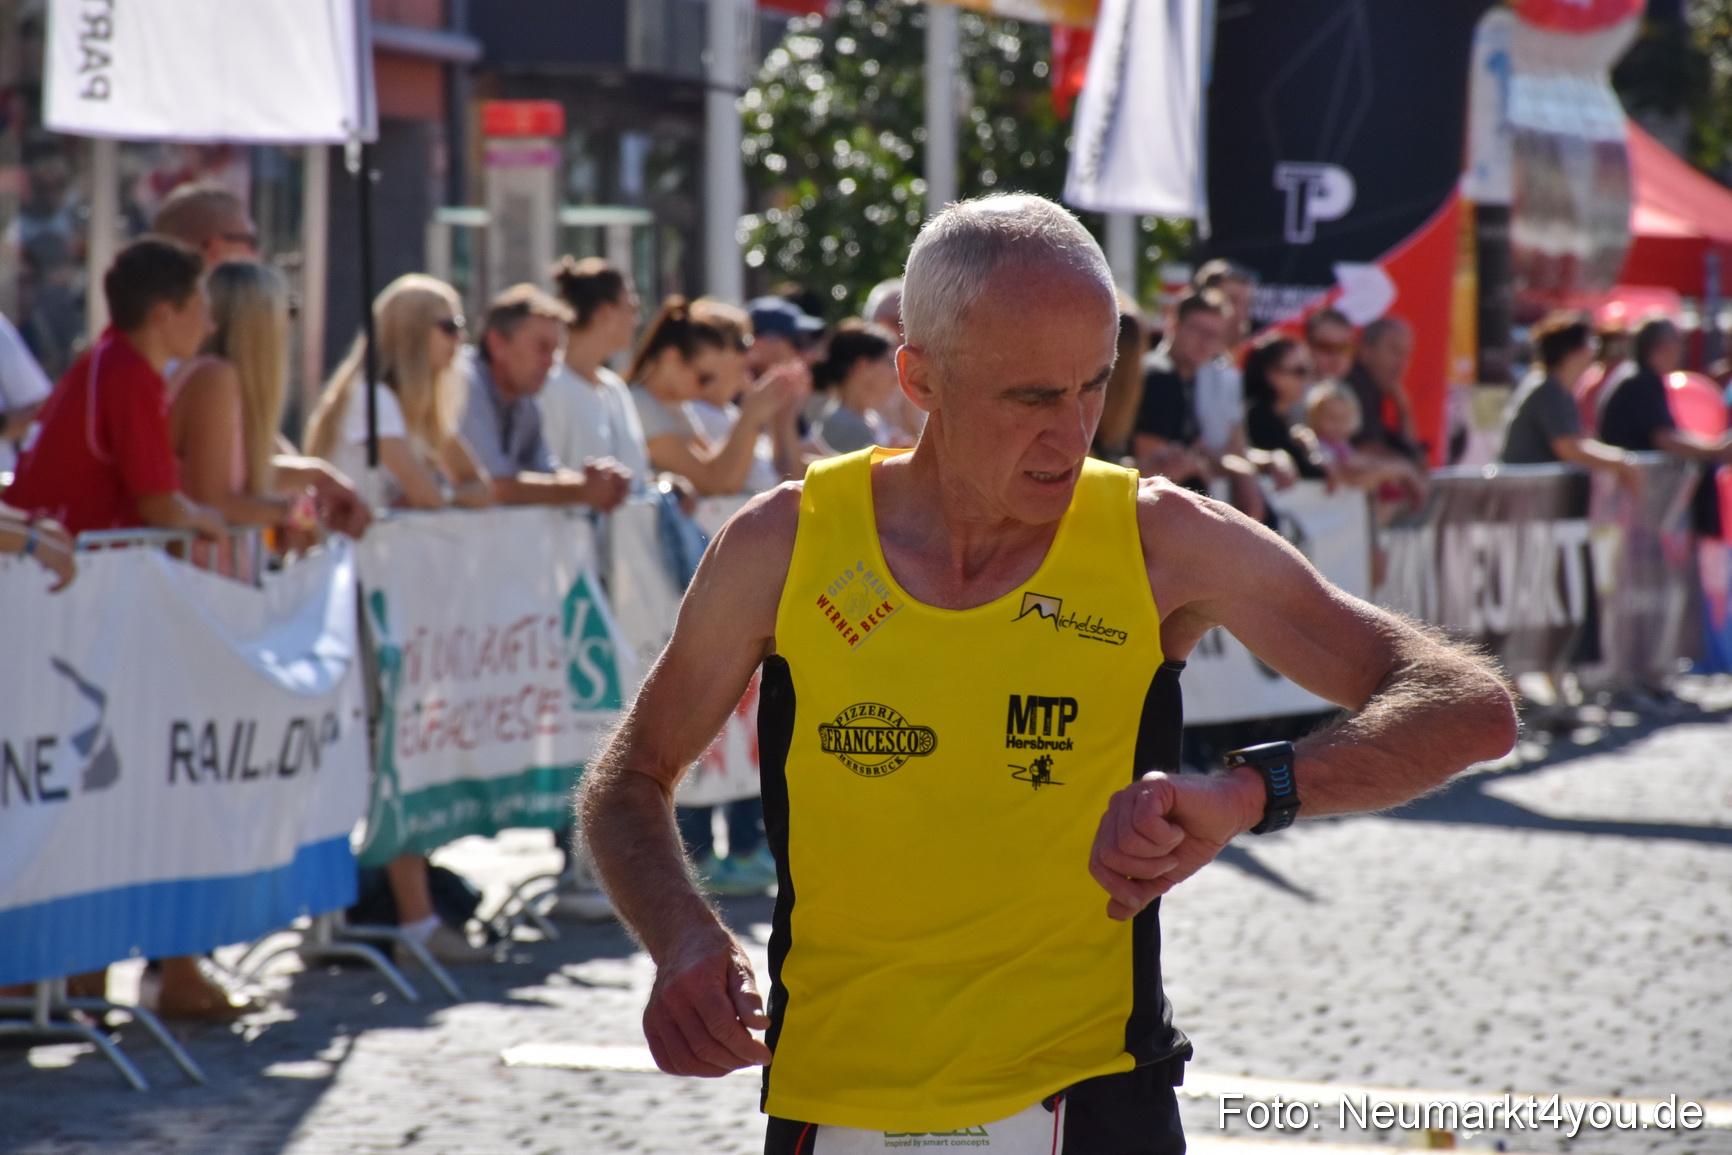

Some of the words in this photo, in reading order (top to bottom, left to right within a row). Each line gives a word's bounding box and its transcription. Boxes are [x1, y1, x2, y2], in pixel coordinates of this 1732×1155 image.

[827, 569, 855, 597] GELD
[863, 570, 891, 601] HAUS
[816, 594, 860, 646] WERNER
[860, 601, 894, 633] BECK
[1011, 602, 1128, 646] Michelsberg
[835, 705, 904, 728] PIZZERIA
[1006, 694, 1078, 737] MTP
[827, 728, 919, 753] FRANCESCO
[1006, 735, 1074, 751] Hersbruck
[839, 754, 904, 776] HERSBRUCK
[884, 1139, 912, 1148] inspired
[913, 1139, 922, 1149] by
[923, 1139, 948, 1147] smart
[950, 1139, 990, 1149] concepts
